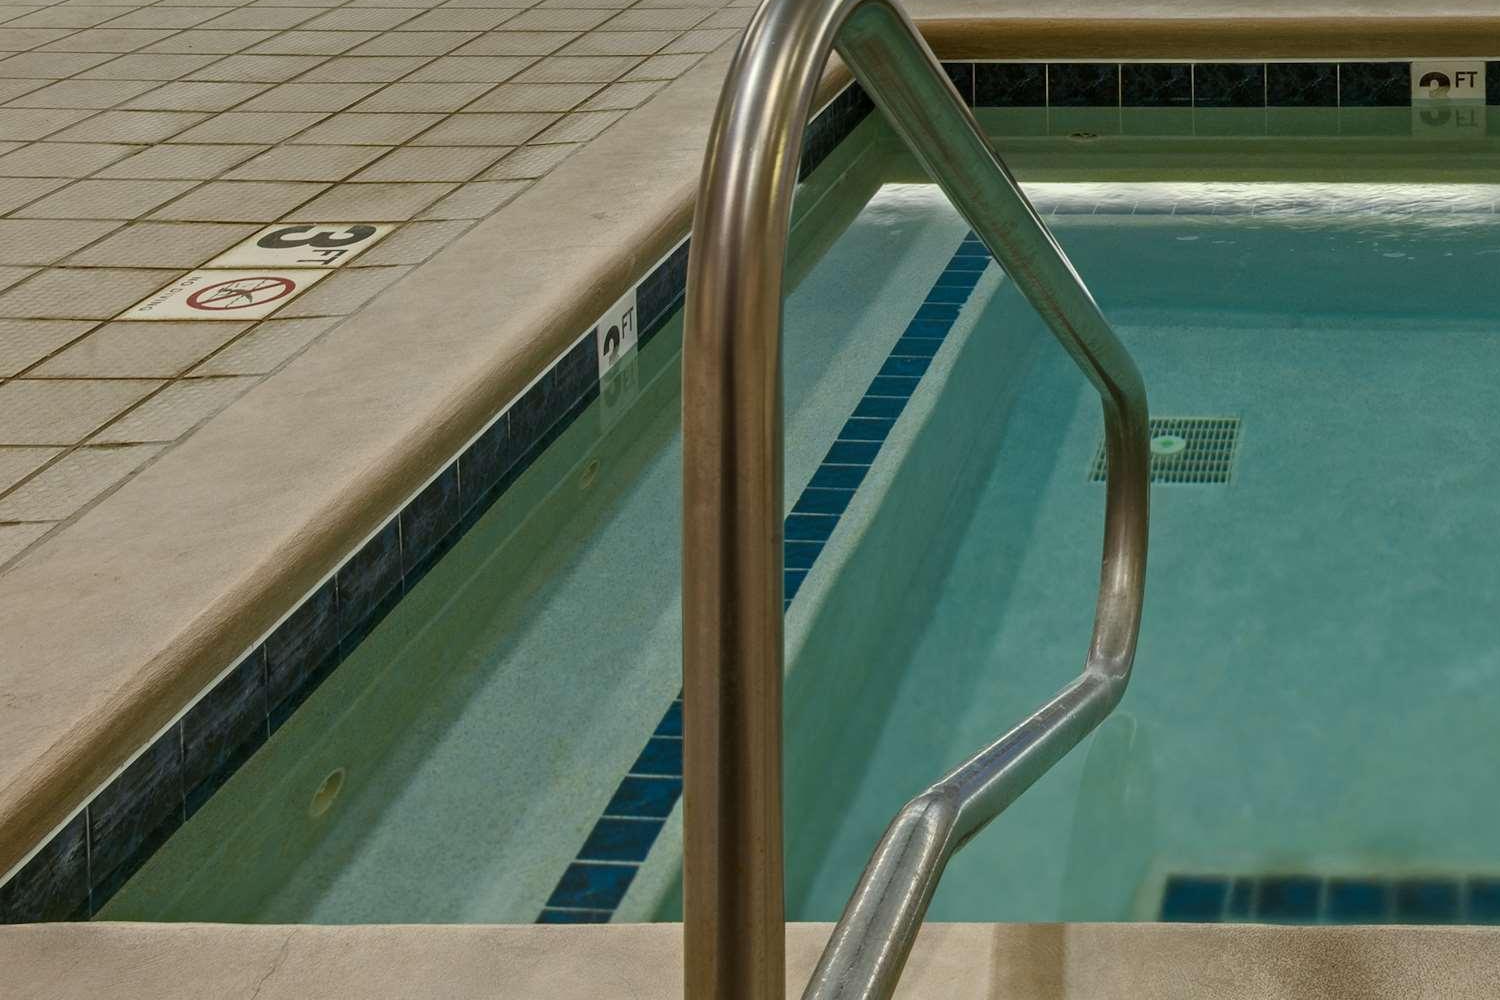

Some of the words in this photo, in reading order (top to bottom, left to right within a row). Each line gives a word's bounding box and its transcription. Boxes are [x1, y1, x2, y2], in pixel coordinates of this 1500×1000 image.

[1455, 71, 1478, 88] FT
[256, 224, 377, 249] 3
[297, 249, 350, 266] FT
[622, 305, 634, 339] FT
